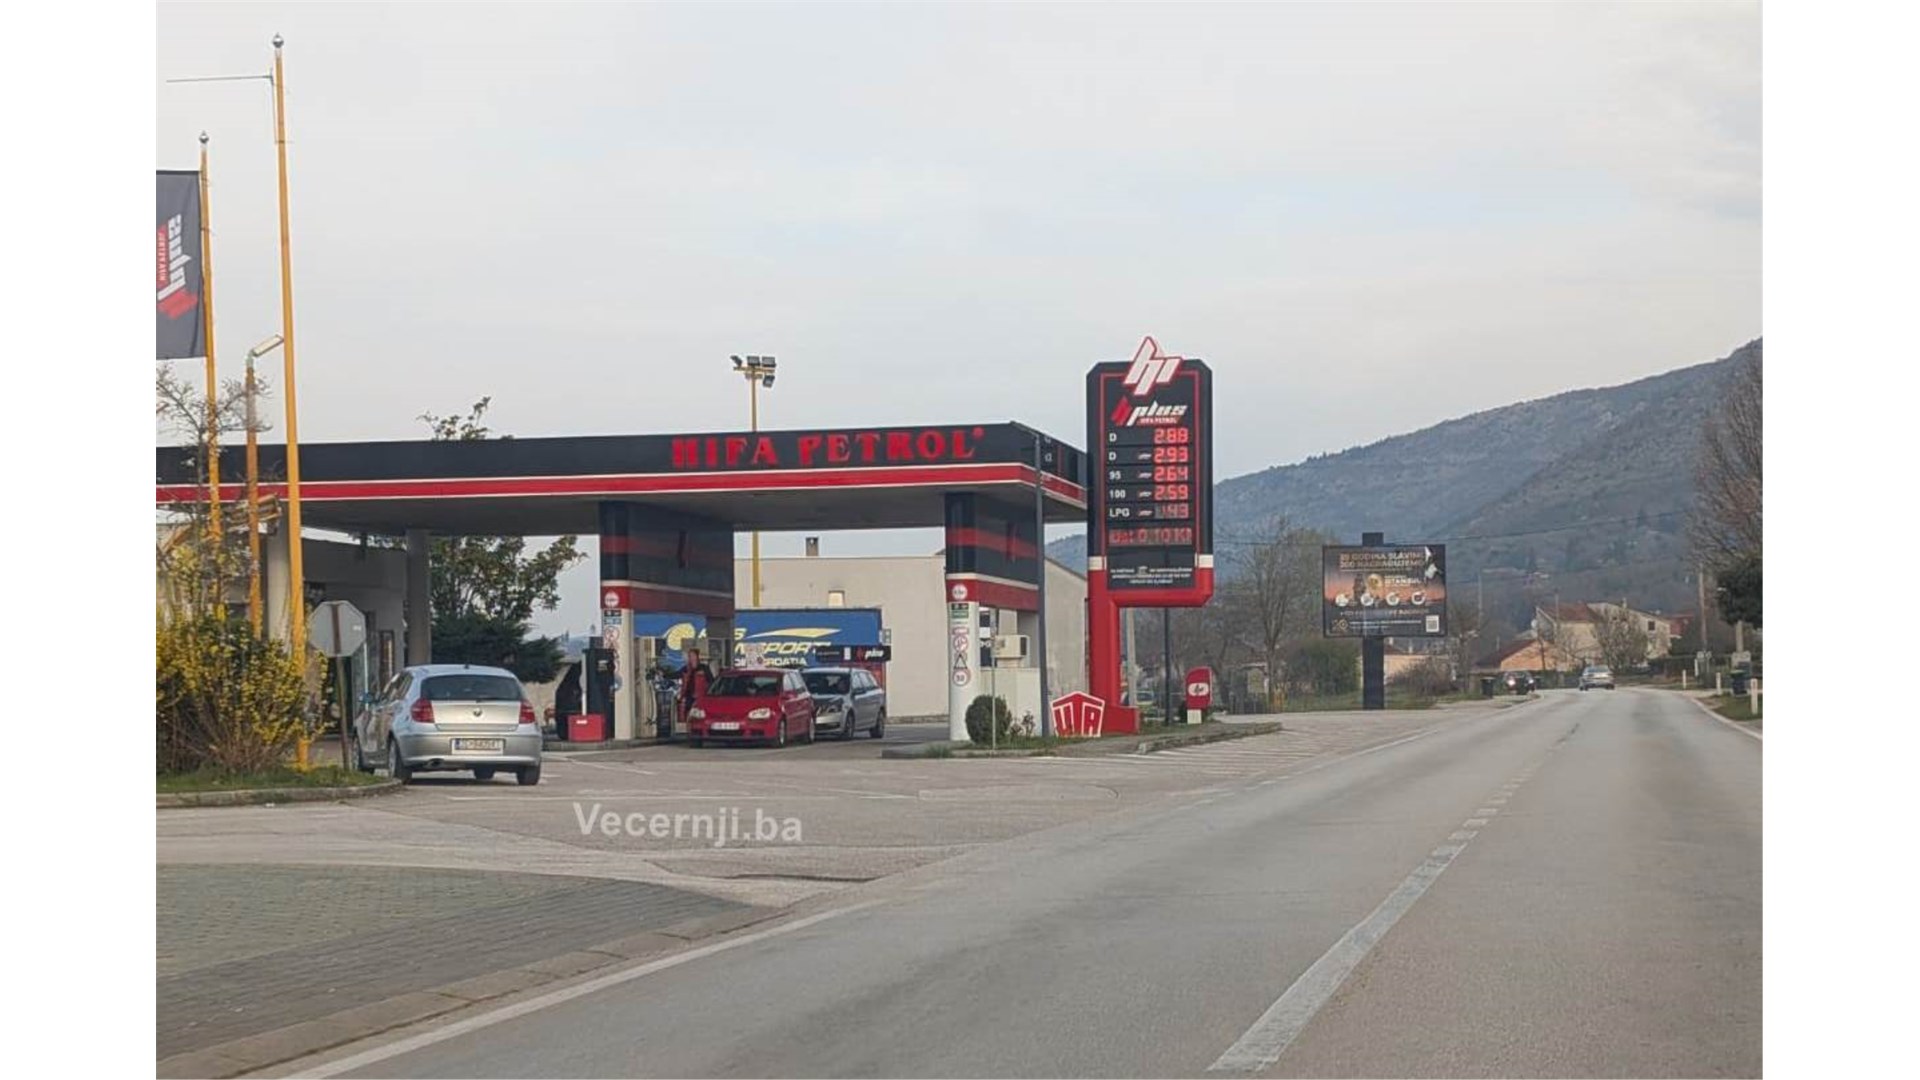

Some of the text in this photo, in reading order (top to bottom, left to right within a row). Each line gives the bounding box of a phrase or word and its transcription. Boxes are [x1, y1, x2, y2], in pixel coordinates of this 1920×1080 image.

[1109, 432, 1117, 442] D
[671, 427, 978, 468] HIFA PETROL
[1108, 451, 1117, 461] D
[1109, 470, 1121, 480] 95
[1109, 489, 1126, 499] 100
[1109, 507, 1130, 518] LPG
